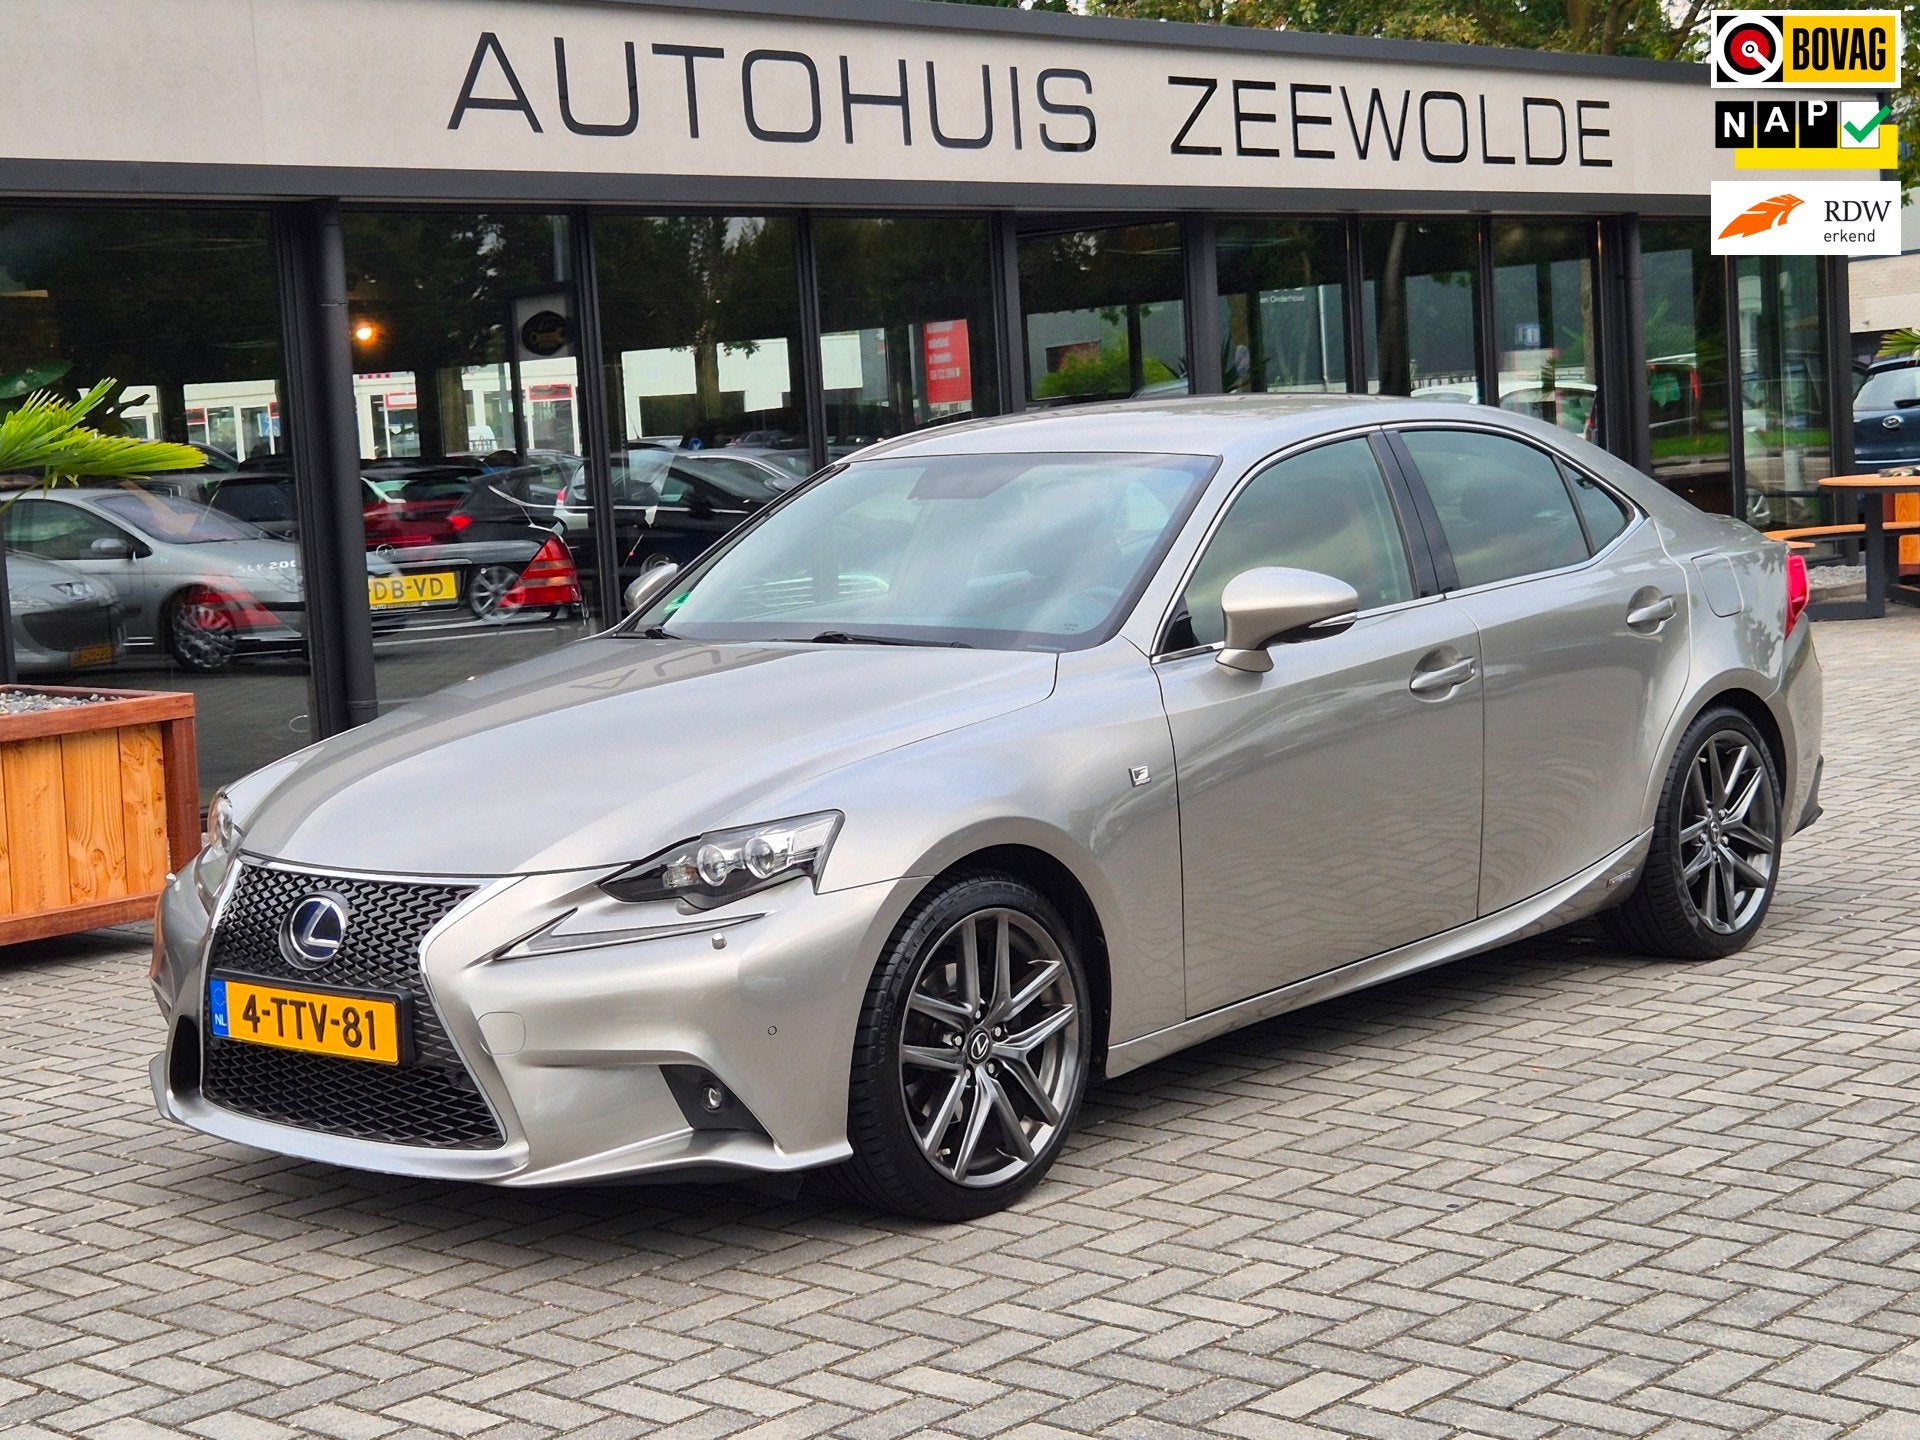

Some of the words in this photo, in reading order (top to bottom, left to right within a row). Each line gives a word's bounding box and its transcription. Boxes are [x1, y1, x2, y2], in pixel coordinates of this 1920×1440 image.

[447, 31, 1097, 153] AUTOHUIS
[1167, 75, 1613, 168] ZEEWOLDE
[214, 1012, 227, 1028] NL
[241, 993, 376, 1051] 4-TTV-81
